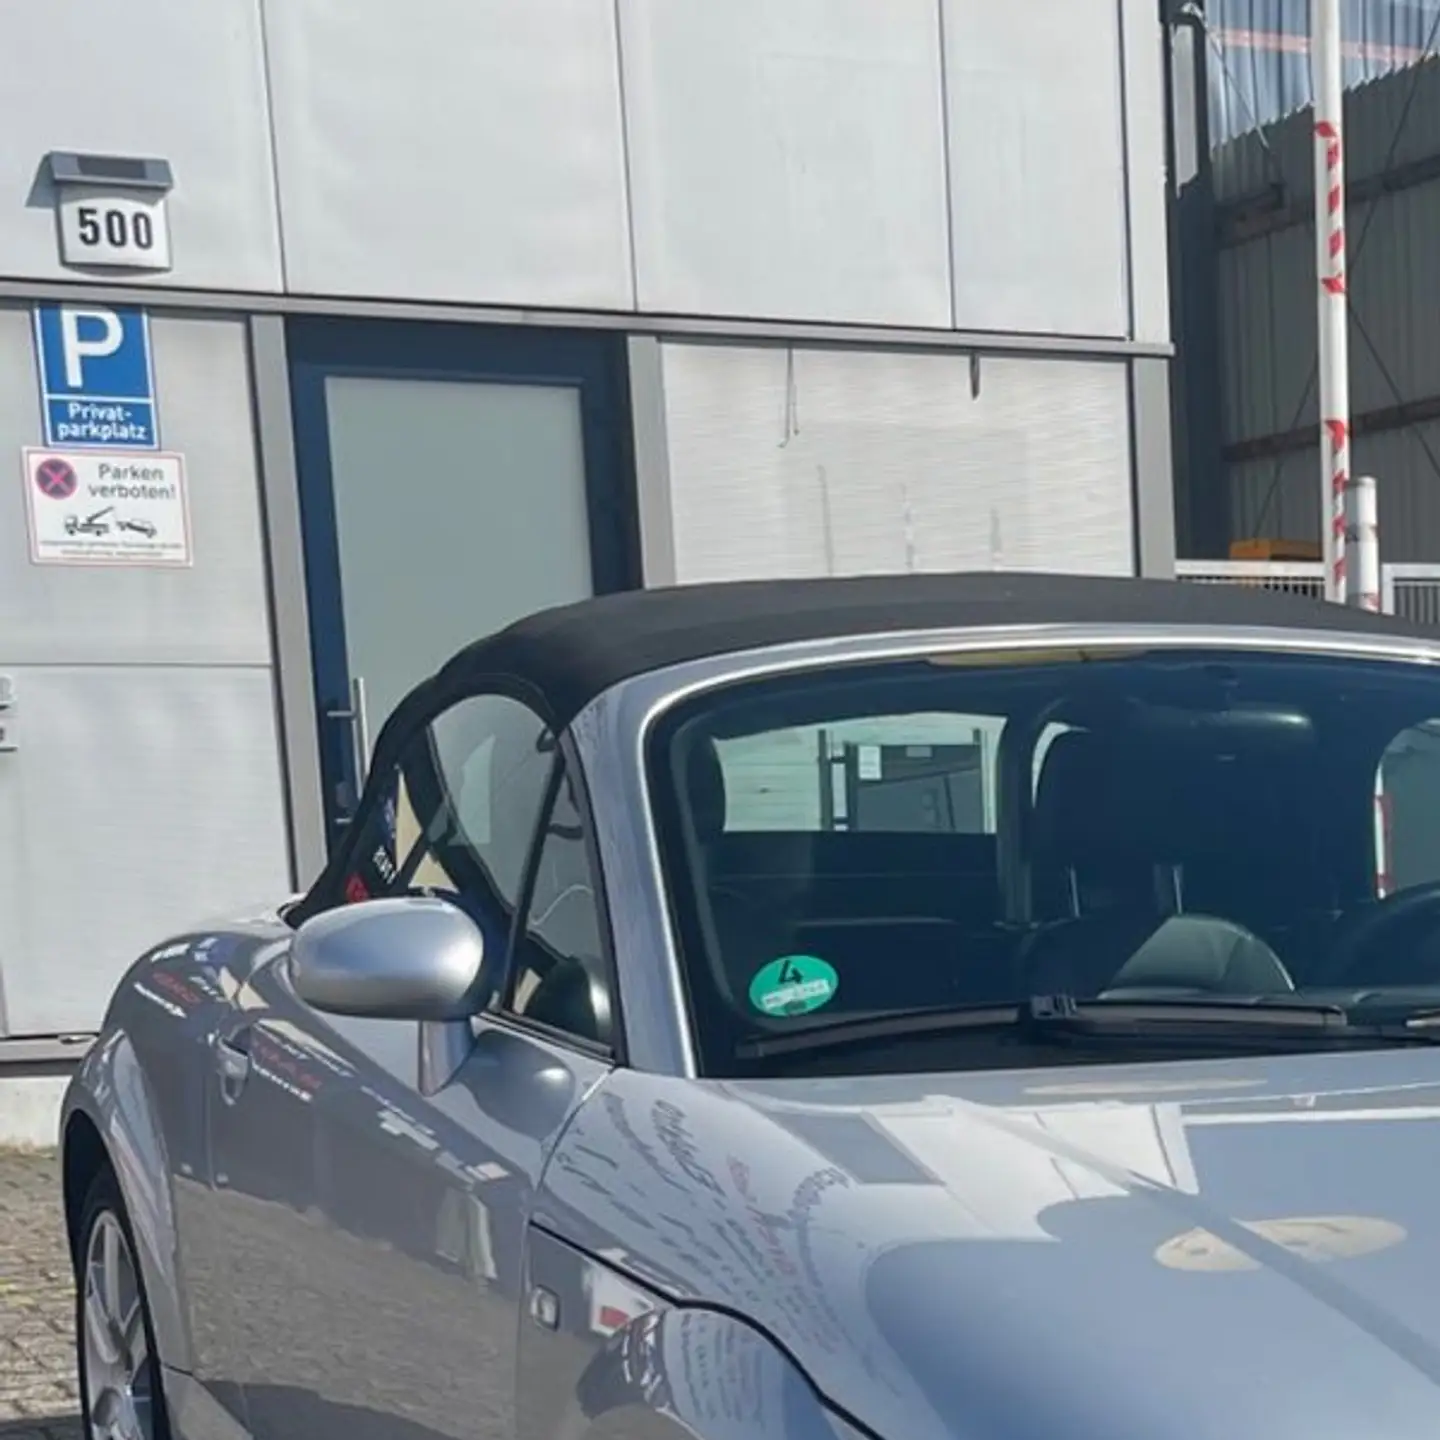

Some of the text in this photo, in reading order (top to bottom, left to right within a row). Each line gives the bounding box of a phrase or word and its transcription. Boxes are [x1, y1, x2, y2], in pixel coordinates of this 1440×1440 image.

[77, 207, 153, 249] 500
[61, 304, 123, 388] P
[69, 403, 132, 421] Privat-
[57, 422, 147, 440] parkplatz
[98, 464, 163, 481] Parken
[88, 484, 176, 499] verboten!
[778, 960, 804, 984] 4
